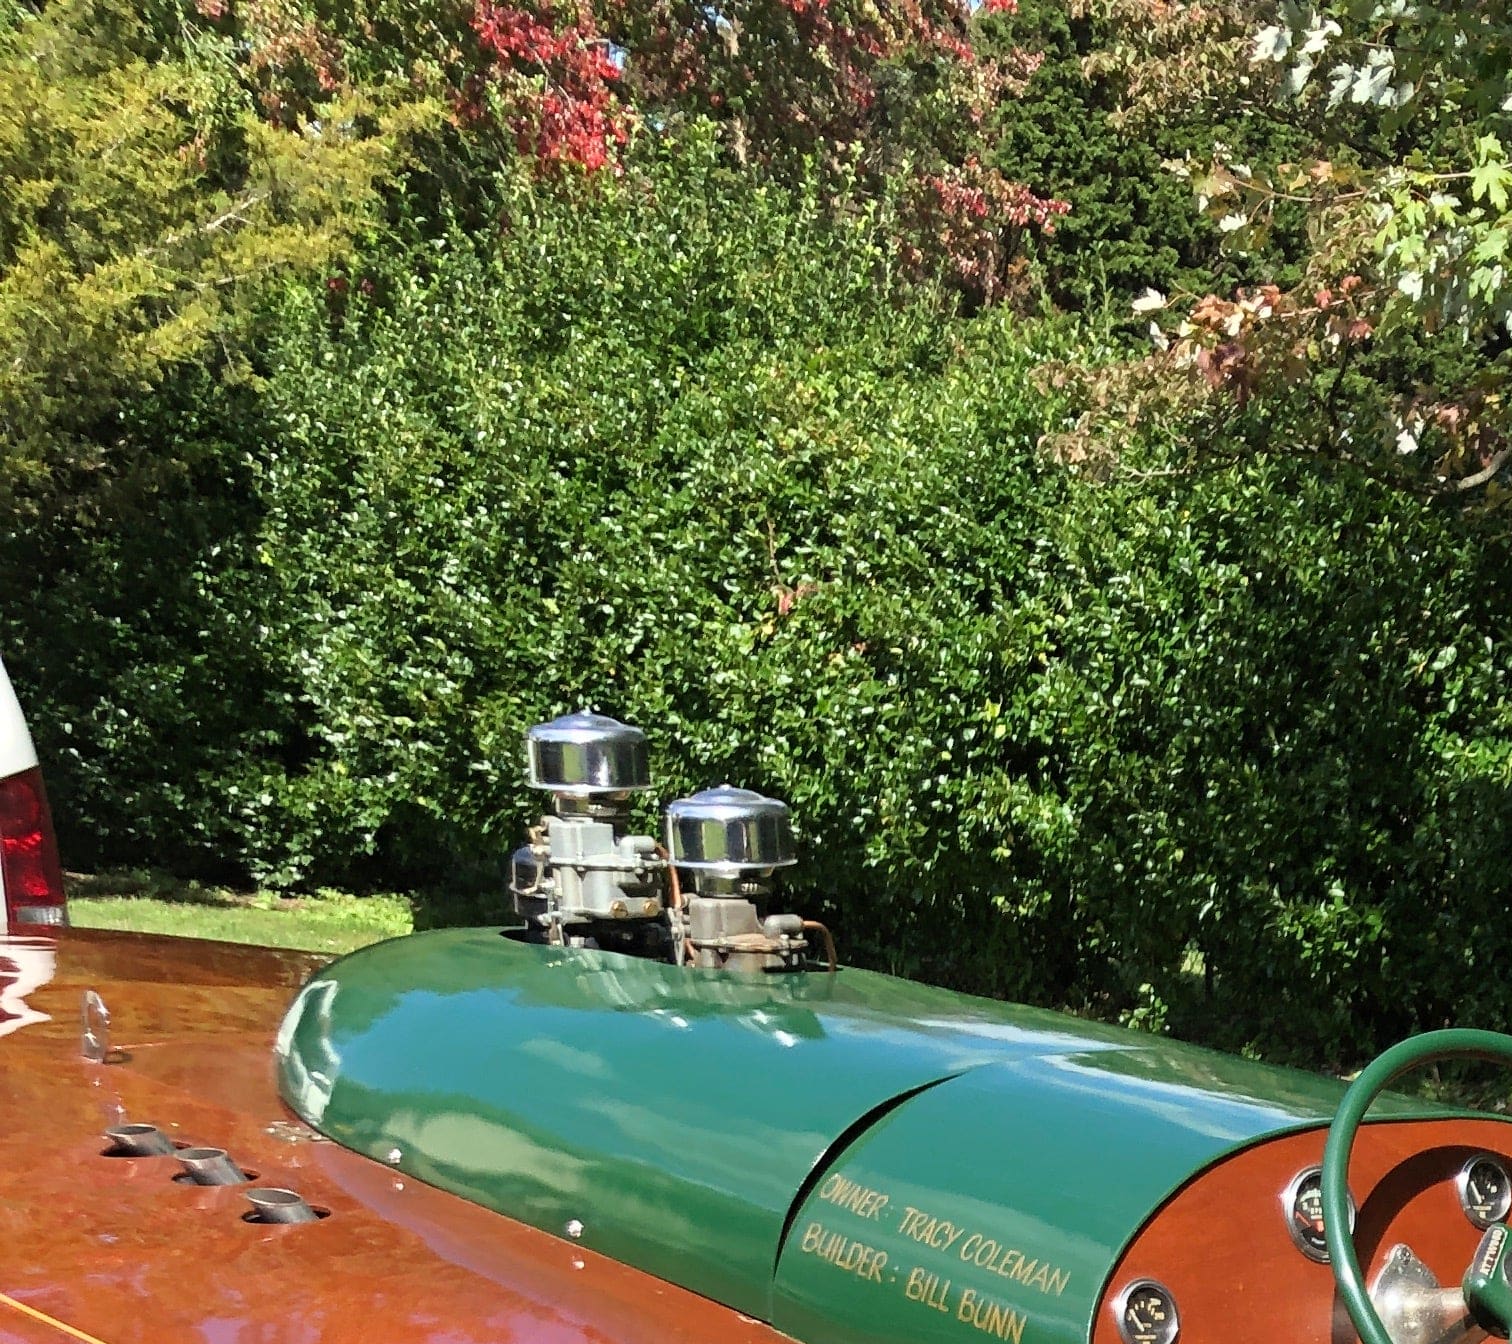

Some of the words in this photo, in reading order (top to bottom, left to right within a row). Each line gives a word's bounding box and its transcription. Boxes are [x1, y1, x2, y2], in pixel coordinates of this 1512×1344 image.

[819, 1172, 895, 1221] OWNER:
[898, 1206, 966, 1251] TRACY
[959, 1232, 1071, 1297] COLEMAN
[904, 1266, 951, 1313] BILL
